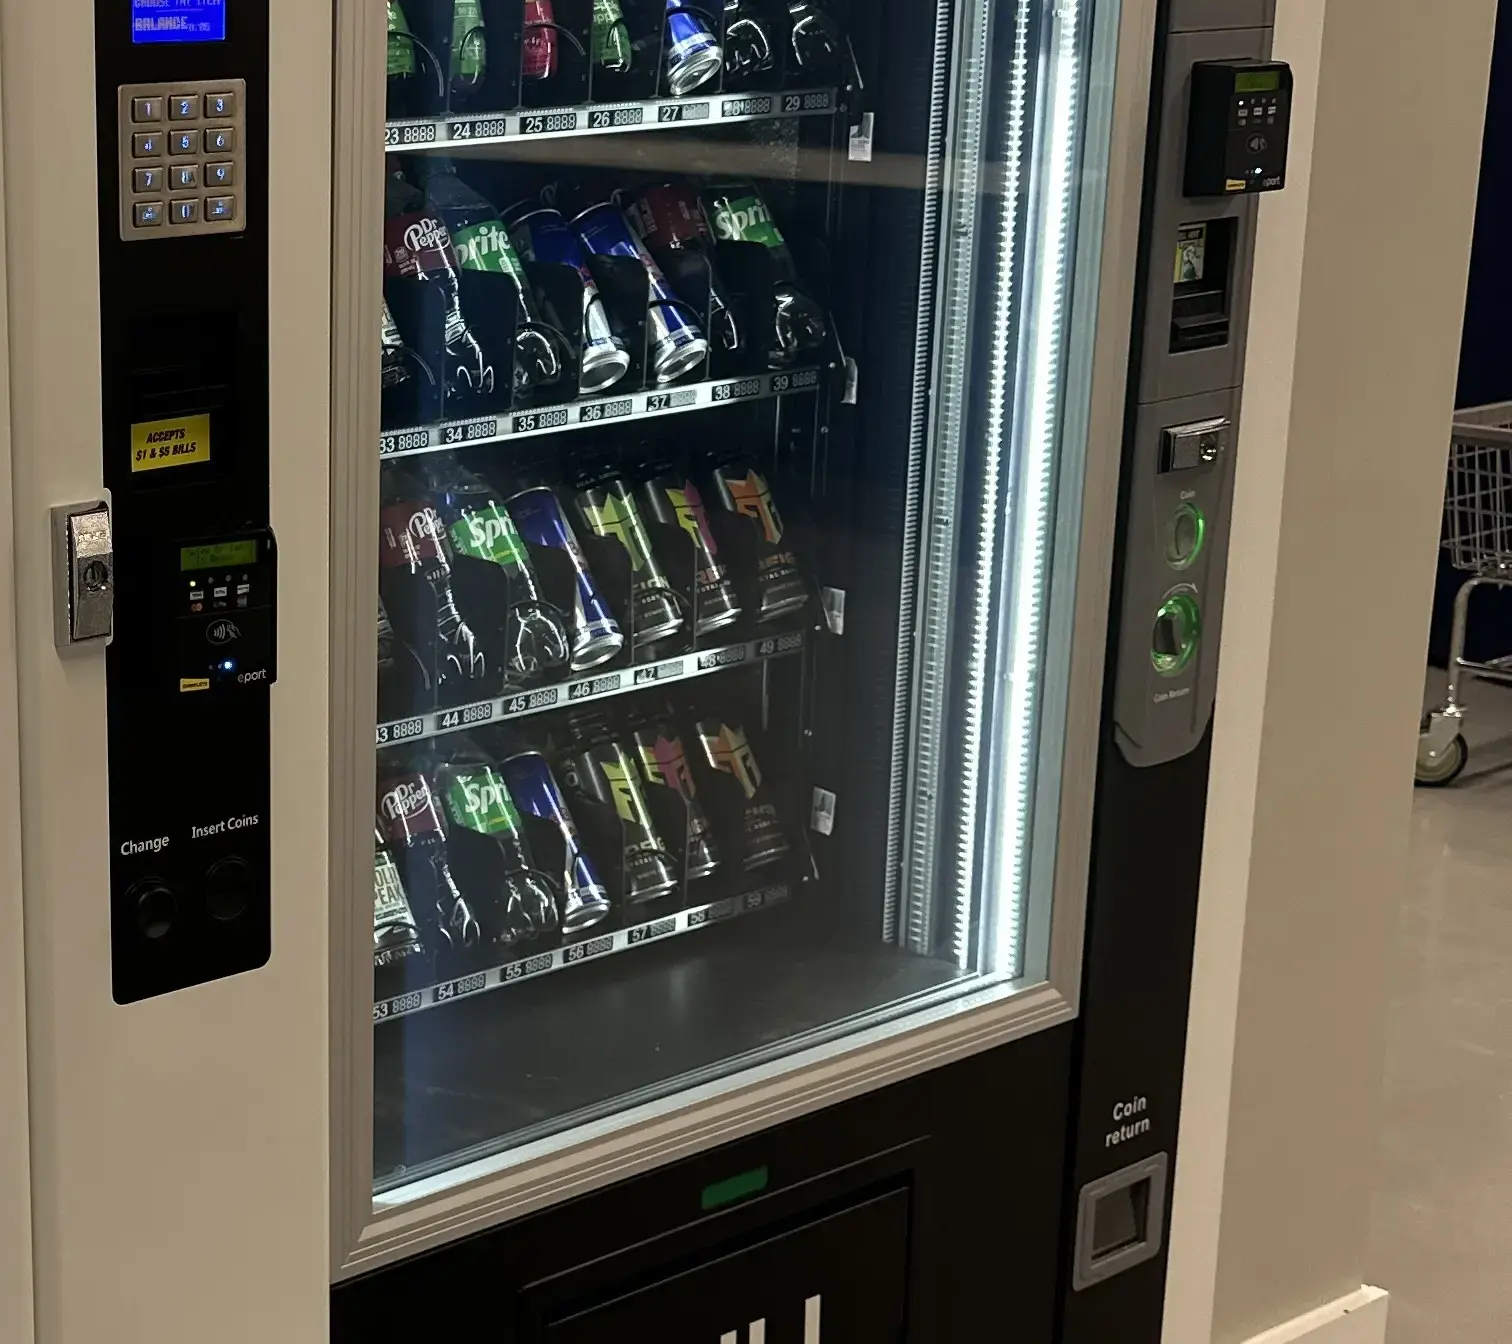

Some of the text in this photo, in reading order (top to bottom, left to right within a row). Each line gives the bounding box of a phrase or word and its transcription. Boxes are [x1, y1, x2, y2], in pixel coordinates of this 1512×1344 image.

[785, 95, 800, 111] 29
[593, 111, 610, 128] 26
[662, 105, 679, 122] 27
[453, 121, 471, 140] 24
[525, 116, 543, 134] 25
[419, 217, 439, 234] Dr
[773, 375, 789, 392] 39
[714, 384, 731, 401] 38
[650, 394, 668, 411] 37
[584, 403, 602, 420] 36
[518, 415, 535, 432] 35
[145, 427, 186, 444] ACCEPTS
[445, 427, 463, 444] 34
[135, 448, 148, 462] $1
[172, 441, 197, 456] BILLS
[237, 667, 267, 684] eport
[573, 681, 590, 698] 46
[508, 697, 526, 713] 45
[441, 711, 460, 728] 44
[191, 813, 259, 839] Insert Coins
[120, 835, 170, 856] Change
[505, 964, 522, 981] 55
[438, 984, 454, 1001] 54
[1112, 1095, 1148, 1121] Coin
[1104, 1117, 1151, 1148] return
